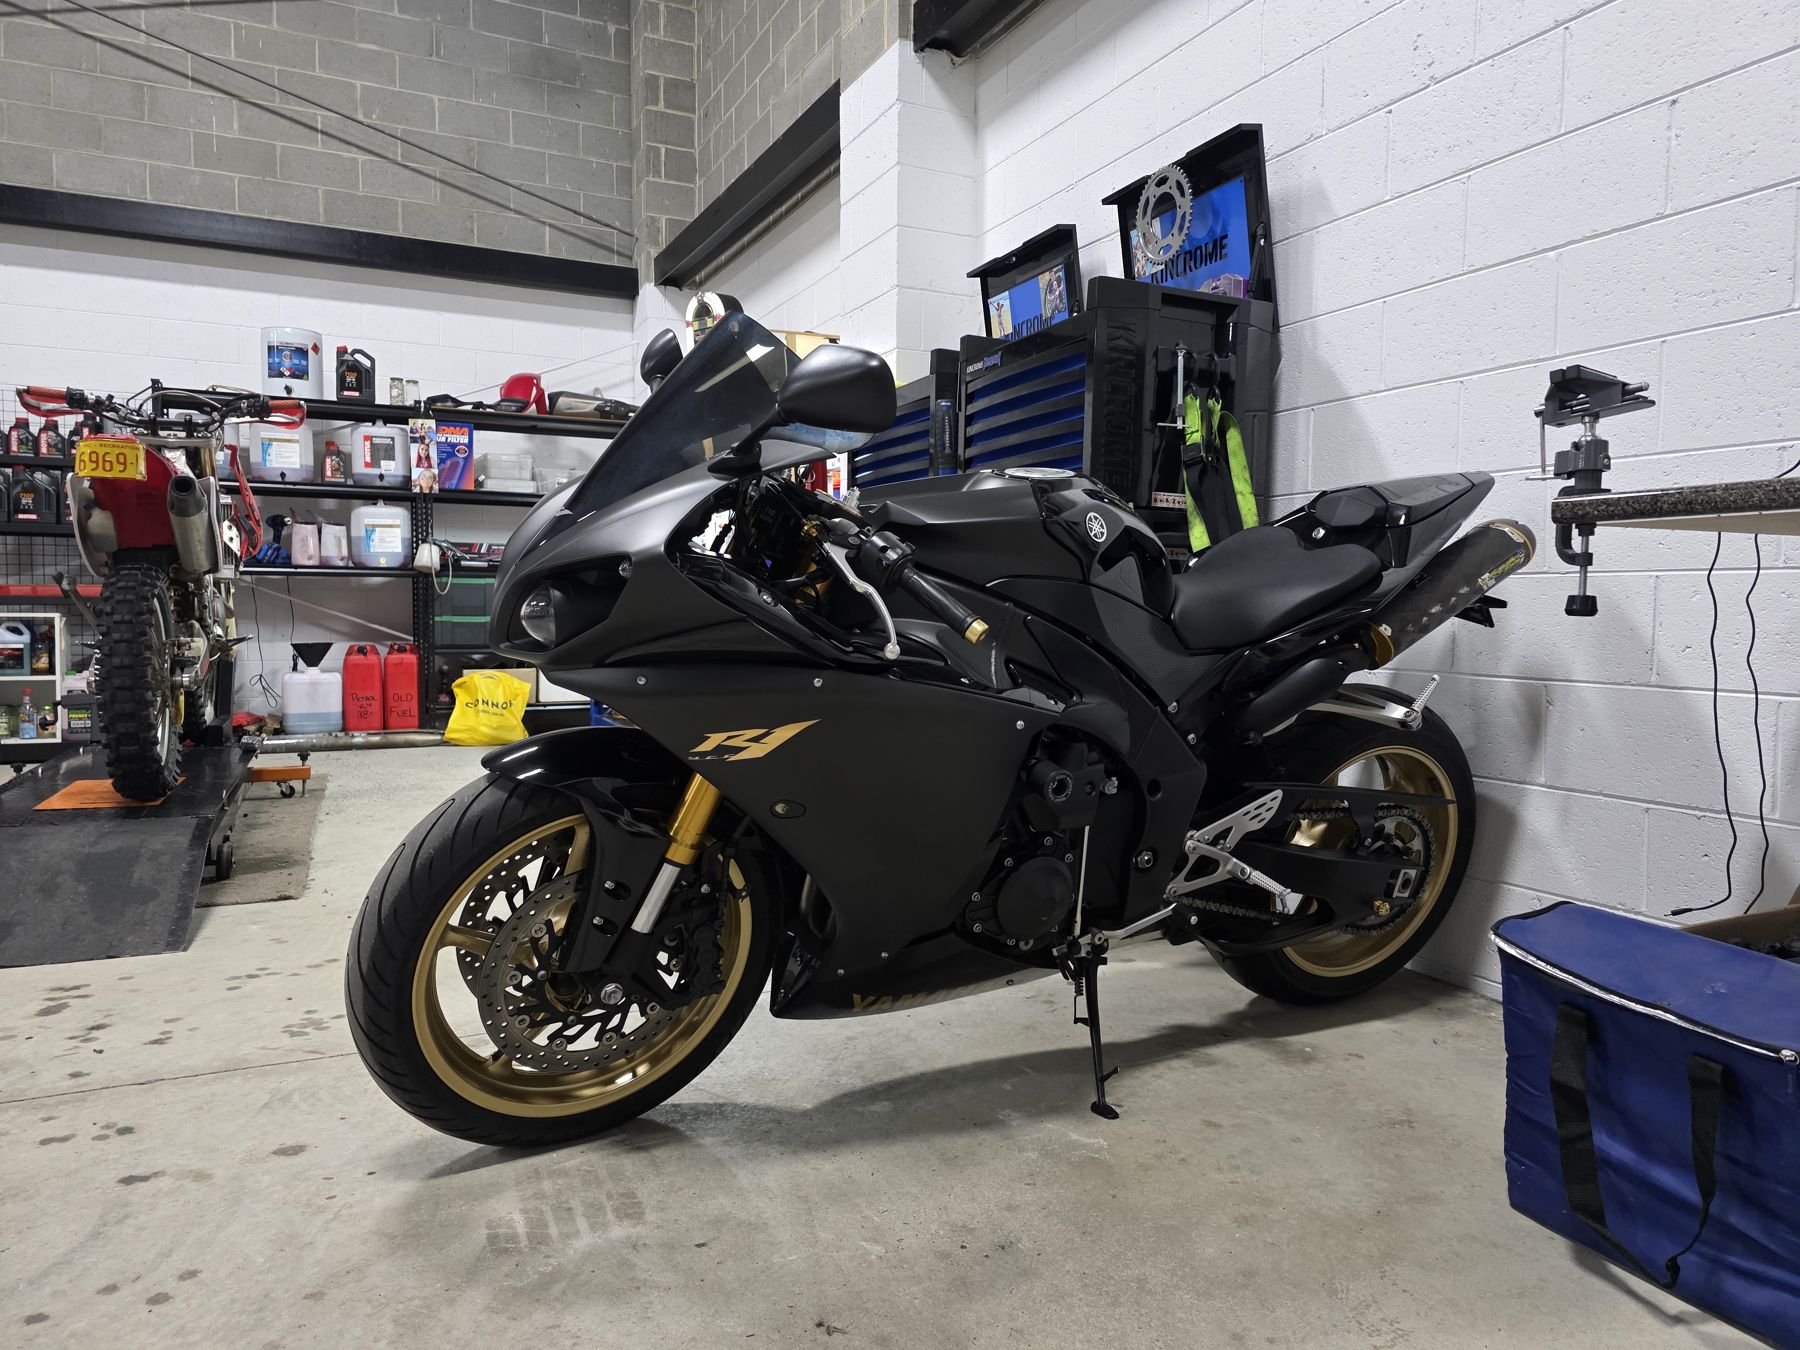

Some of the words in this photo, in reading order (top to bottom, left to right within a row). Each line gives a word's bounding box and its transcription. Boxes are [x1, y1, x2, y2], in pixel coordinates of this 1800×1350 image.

[1151, 234, 1229, 285] KINCROME
[1102, 320, 1137, 489] KINCROME
[364, 440, 372, 464] MOTUL
[389, 706, 416, 718] FUEL
[392, 693, 413, 702] OLD
[689, 719, 822, 762] R1
